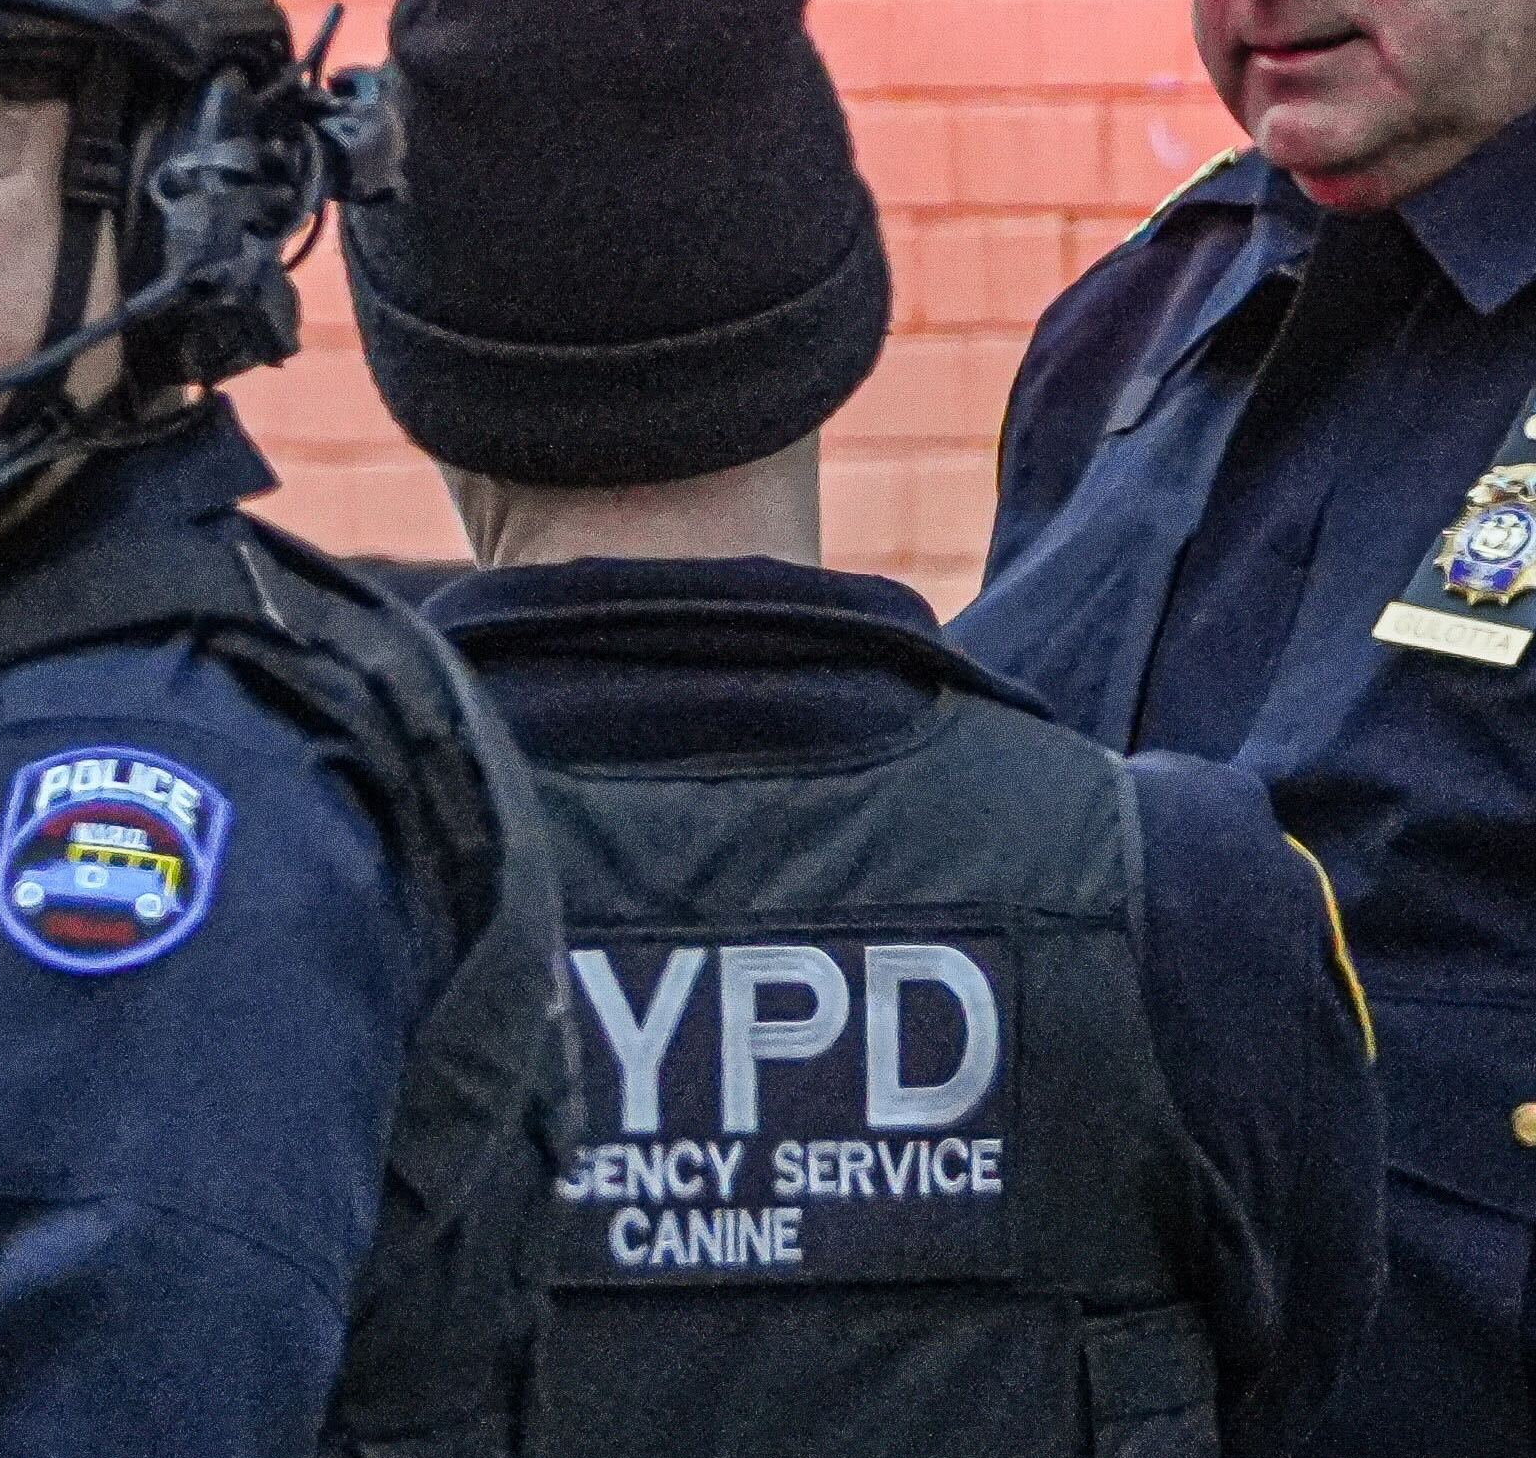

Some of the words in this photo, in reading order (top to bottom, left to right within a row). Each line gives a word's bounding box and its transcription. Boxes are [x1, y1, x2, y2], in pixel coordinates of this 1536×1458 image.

[33, 758, 201, 826] POLICE
[773, 1138, 1003, 1199] SERVICE
[608, 1206, 804, 1266] CANINE
